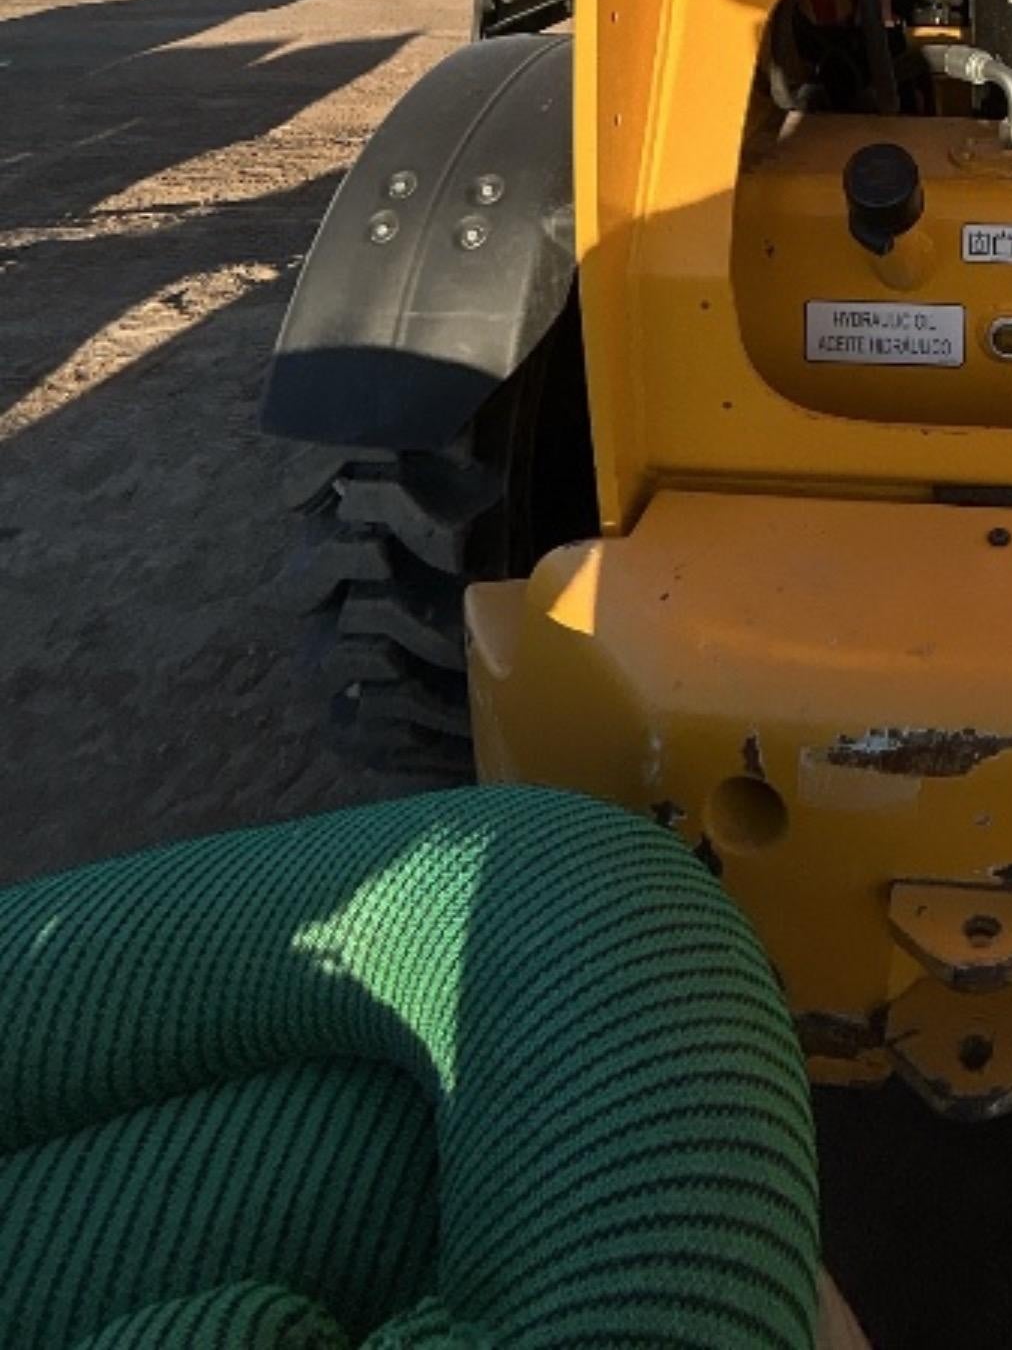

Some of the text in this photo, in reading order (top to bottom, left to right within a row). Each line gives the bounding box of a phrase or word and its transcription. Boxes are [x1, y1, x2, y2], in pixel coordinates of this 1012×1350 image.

[832, 310, 938, 332] HYDRAULIC OIL
[817, 335, 866, 354] ACEITE
